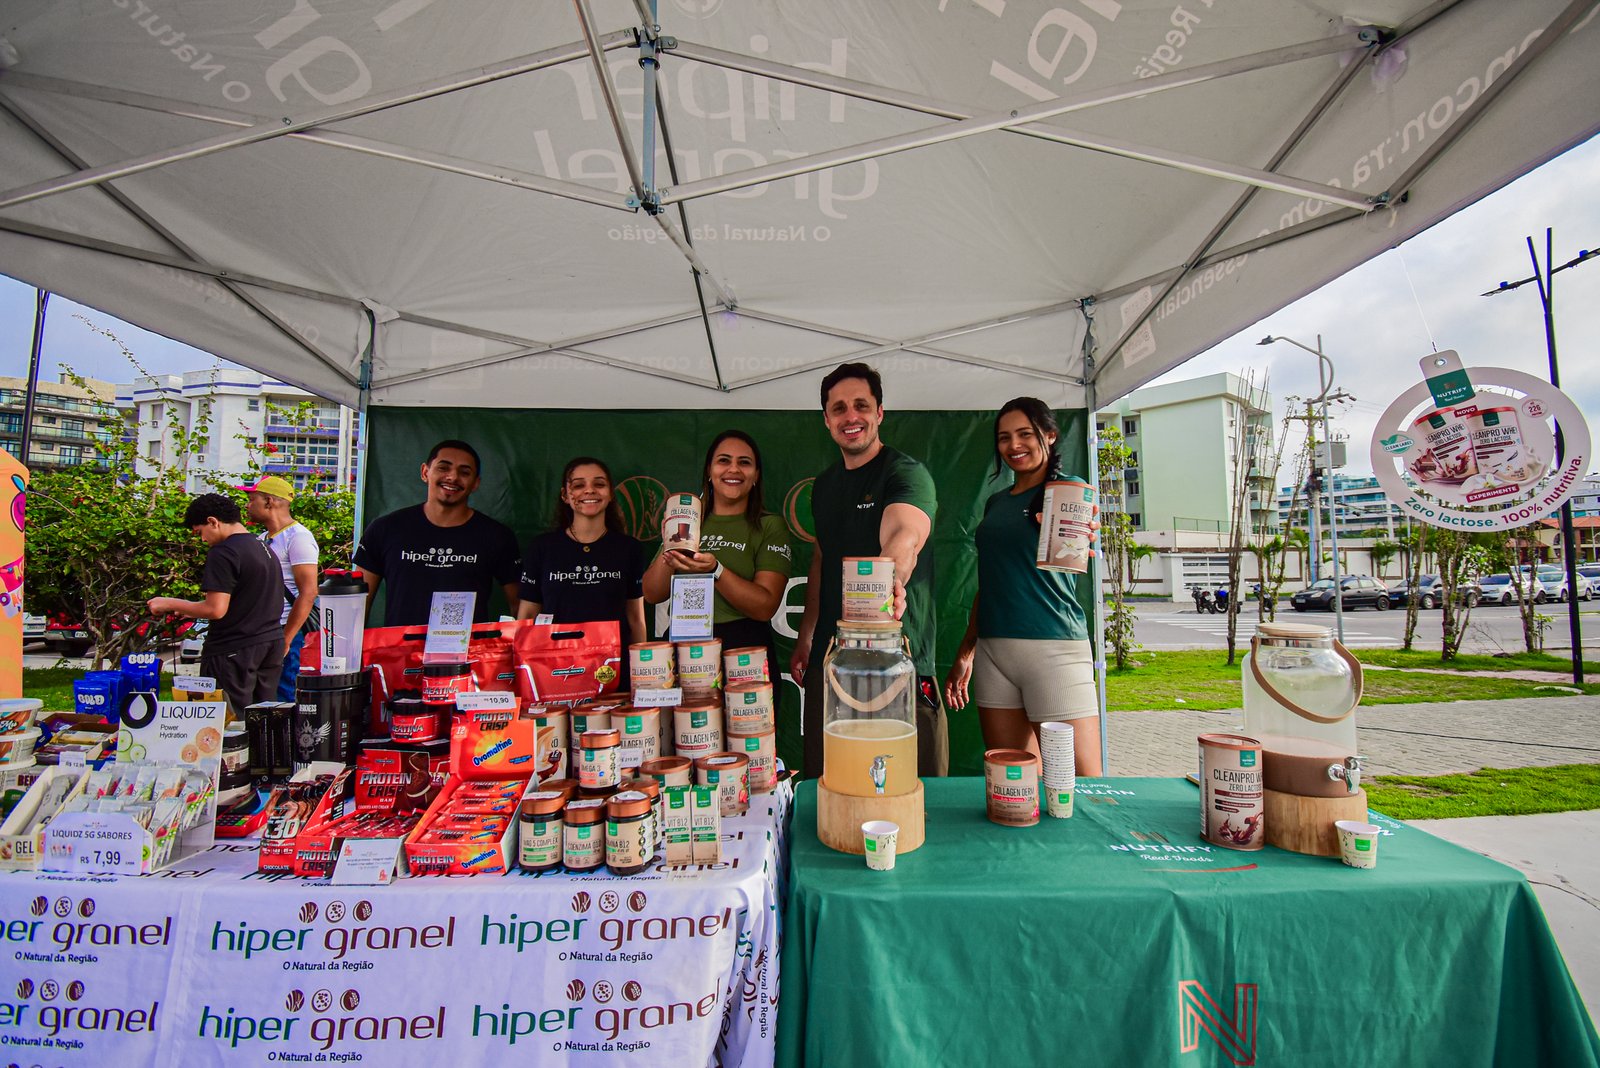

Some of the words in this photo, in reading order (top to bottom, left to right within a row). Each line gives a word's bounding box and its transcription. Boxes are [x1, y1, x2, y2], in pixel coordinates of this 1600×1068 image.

[1437, 386, 1466, 398] NUTRIFY
[1456, 407, 1475, 415] NOVO
[1528, 405, 1541, 413] 22G
[1404, 496, 1435, 517] Zero
[1438, 510, 1498, 527] lactose.
[1502, 504, 1543, 524] 100%
[1543, 455, 1583, 506] nutritiva.
[1469, 486, 1517, 502] EXPERIMENTE
[708, 540, 746, 552] granel
[401, 550, 435, 563] hiper
[438, 554, 478, 565] granel
[550, 570, 580, 581] hiper
[584, 570, 620, 581] granel
[846, 584, 870, 592] COLLAGEN
[872, 584, 886, 592] DERM
[162, 707, 216, 719] LIQUIDZ
[473, 712, 514, 721] PROTEIN
[733, 708, 754, 716] COLLAGEN
[456, 726, 466, 734] 12
[480, 721, 508, 731] CRISP
[160, 732, 187, 740] Hydration
[645, 737, 655, 747] PRO
[681, 734, 709, 744] COLLAGEN
[710, 731, 720, 742] PRO
[472, 738, 512, 766] Ovomaltine
[360, 773, 411, 784] PROTEIN
[1213, 768, 1254, 784] CLEANPRO
[368, 785, 405, 797] CRISP
[722, 786, 735, 796] HMB
[994, 786, 1020, 796] COLLAGEN
[1229, 784, 1243, 792] ZERO
[668, 819, 676, 827] VIT
[677, 819, 688, 827] B12
[52, 830, 83, 838] LIQUIDZ
[97, 831, 132, 840] SABORES
[15, 841, 34, 854] GEL
[536, 837, 558, 846] COMPLEX
[1110, 843, 1212, 853] NUTRIFY
[94, 851, 120, 868] 7,99
[296, 851, 338, 860] PROTEIN
[410, 855, 455, 864] PROTEIN
[461, 849, 497, 869] Ovomaltine
[1172, 854, 1214, 862] Foods
[302, 862, 333, 871] CRISP
[52, 917, 172, 952] granel
[480, 913, 588, 953] hiper
[599, 907, 732, 952] granel
[211, 921, 314, 959] hiper
[323, 916, 455, 960] granel
[15, 952, 22, 961] O
[24, 952, 52, 963] Natural
[54, 953, 65, 962] da
[67, 953, 98, 965] Região
[558, 952, 568, 961] O
[569, 951, 603, 962] Natural
[604, 952, 617, 962] da
[620, 951, 653, 963] Região
[283, 961, 291, 970] O
[292, 961, 325, 971] Natural
[327, 961, 339, 971] da
[341, 960, 374, 973] Região
[760, 992, 768, 1004] da
[471, 1003, 583, 1045] hiper
[594, 978, 721, 1041] granel
[38, 1001, 159, 1036] granel
[760, 1007, 768, 1038] Região
[199, 1005, 300, 1048] hiper
[310, 1006, 446, 1050] granel
[1, 1036, 8, 1045] O
[10, 1036, 39, 1048] Natural
[41, 1038, 52, 1048] da
[53, 1038, 84, 1050] Região
[553, 1042, 562, 1052] O
[564, 1041, 599, 1052] Natural
[601, 1041, 614, 1052] da
[616, 1040, 650, 1052] Região
[268, 1053, 276, 1061] O
[278, 1052, 313, 1062] Natural
[315, 1052, 327, 1062] da
[329, 1052, 362, 1063] Região
